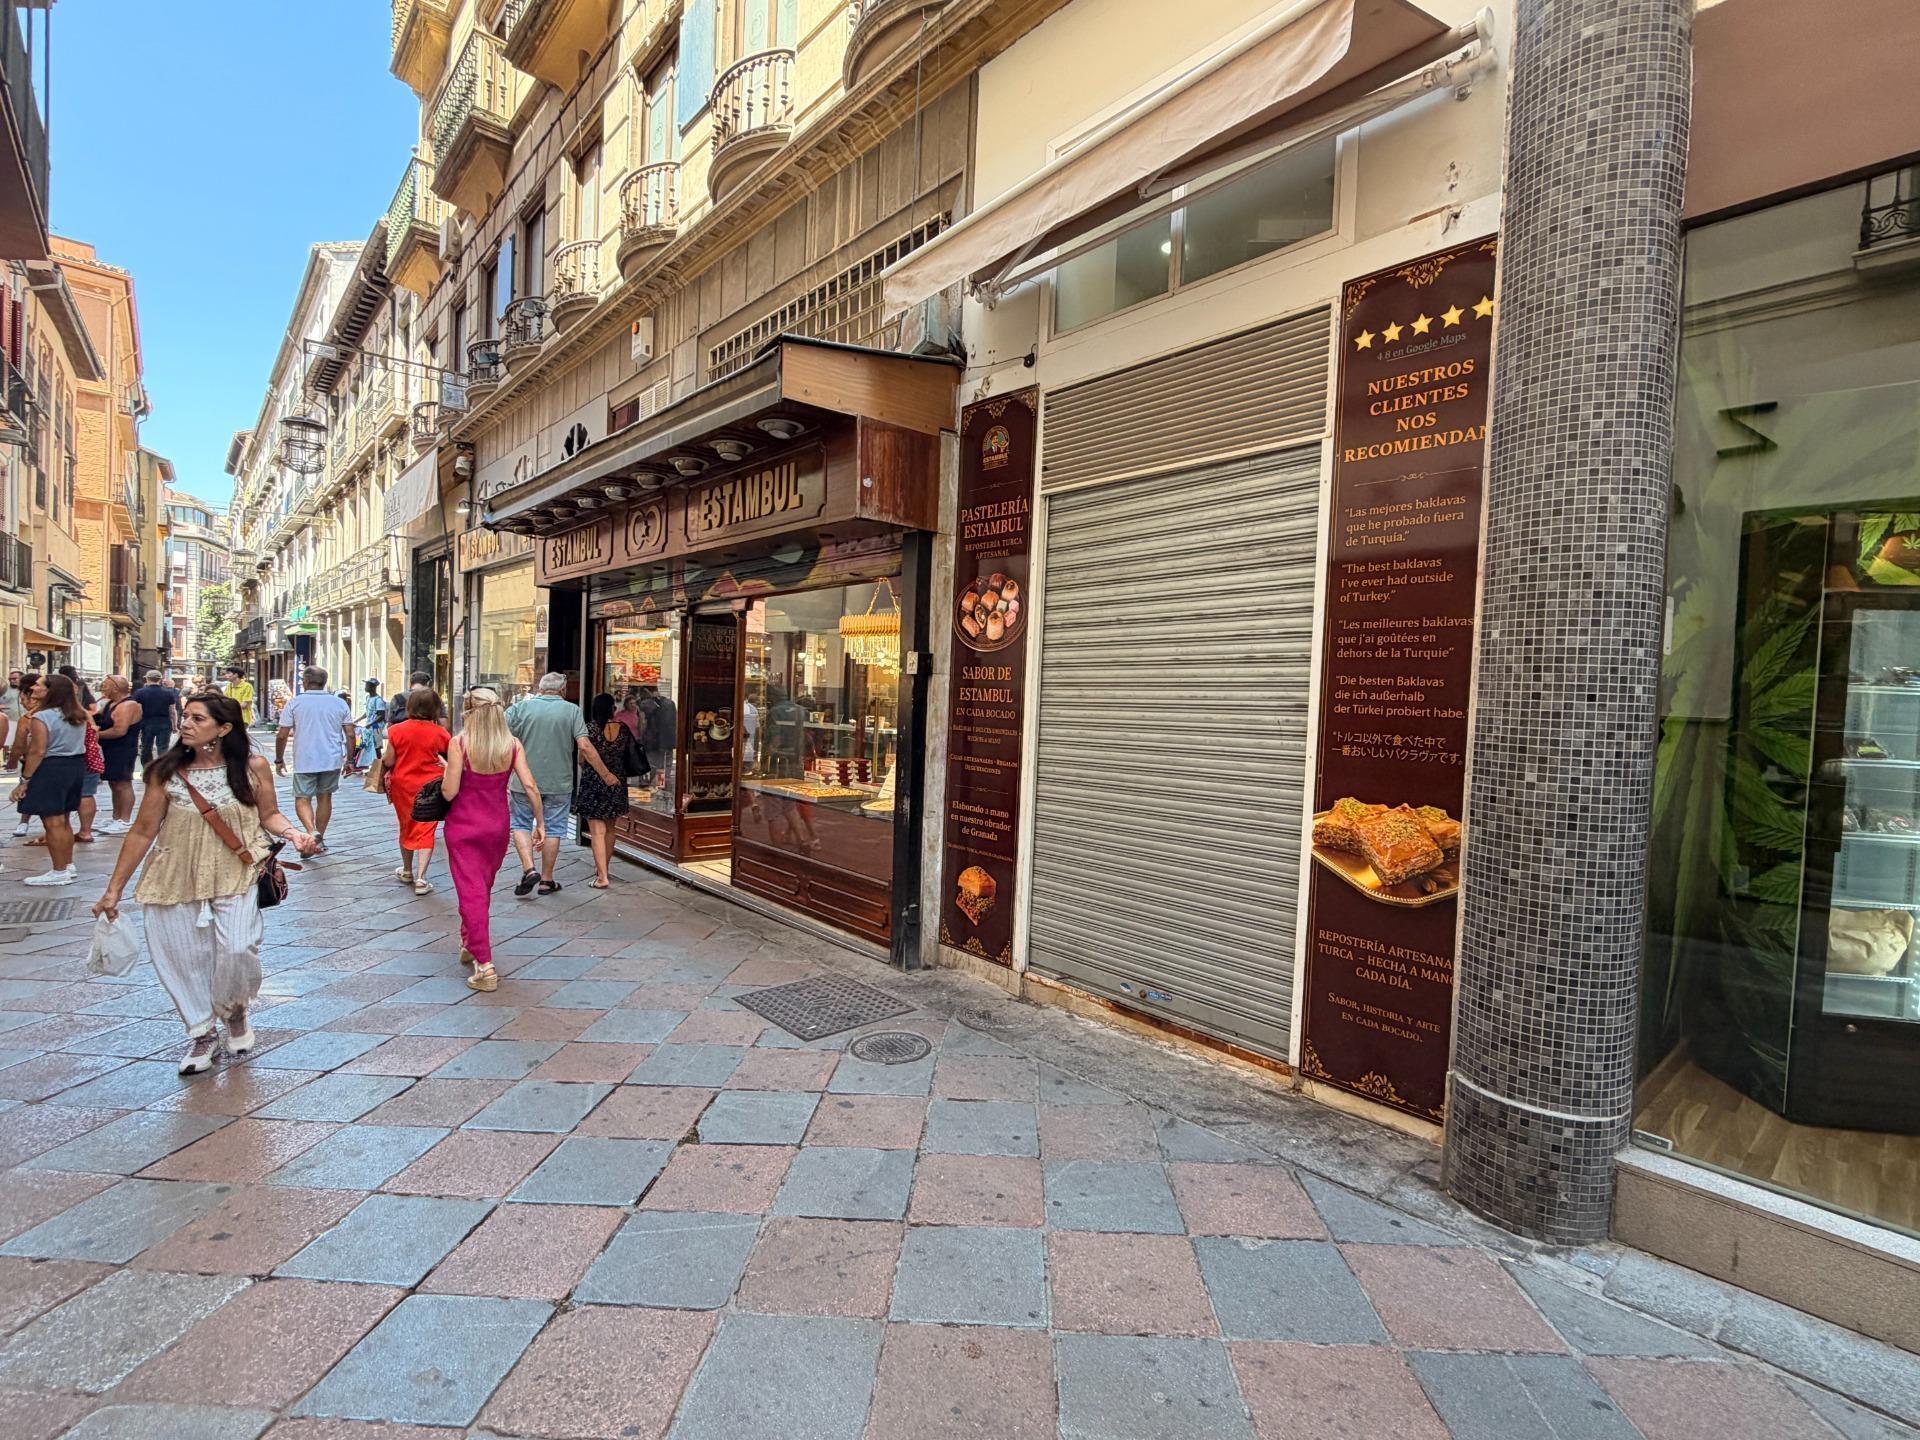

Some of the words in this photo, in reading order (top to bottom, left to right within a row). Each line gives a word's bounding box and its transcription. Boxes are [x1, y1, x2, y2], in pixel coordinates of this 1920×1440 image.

[1393, 348, 1404, 357] en
[1406, 339, 1439, 353] Google
[1440, 333, 1467, 345] Maps
[1366, 359, 1475, 396] NUESTROS
[1369, 383, 1470, 416] CLIENTES
[1395, 412, 1437, 433] NOS
[700, 462, 803, 531] ESTAMBUL
[961, 495, 1029, 523] PASTELERÍA
[1369, 501, 1412, 516] mejores
[1415, 496, 1466, 509] baklavas
[964, 517, 1024, 539] ESTAMBUL
[1346, 522, 1366, 534] que
[1368, 519, 1380, 531] he
[1383, 513, 1431, 531] probado
[1433, 511, 1464, 523] fuera
[550, 526, 602, 570] ESTAMBUL
[1002, 537, 1023, 547] TURCA
[1345, 536, 1359, 547] de
[975, 549, 1010, 560] ARTESANAL
[1368, 561, 1390, 572] best
[1393, 558, 1442, 570] baklavas
[1341, 577, 1359, 588] I've
[1361, 578, 1384, 587] ever
[1387, 574, 1408, 585] had
[1410, 571, 1454, 583] outside
[1340, 592, 1352, 603] of
[1362, 617, 1420, 629] meilleures
[1422, 616, 1474, 627] baklavas
[1338, 635, 1356, 647] que
[1358, 632, 1375, 646] j'ai
[1377, 632, 1420, 646] goûtées
[1422, 634, 1436, 643] en
[1336, 647, 1373, 658] dehors
[1375, 647, 1389, 658] de
[1391, 647, 1400, 658] la
[962, 665, 995, 680] SABOR
[997, 666, 1012, 681] DE
[1359, 675, 1394, 686] besten
[1397, 676, 1445, 687] Baklavas
[959, 687, 1013, 703] ESTAMBUL
[1334, 690, 1350, 700] die
[1352, 690, 1368, 700] ich
[1369, 690, 1425, 702] außerhalb
[956, 707, 965, 716] EN
[965, 707, 985, 718] CADA
[985, 708, 1016, 720] BOCADO
[1333, 704, 1352, 714] der
[1352, 704, 1383, 716] Türkei
[1386, 705, 1431, 719] probiert
[952, 800, 984, 813] Elaborado
[990, 809, 1009, 818] mano
[950, 813, 959, 821] en
[959, 815, 984, 826] nuestro
[984, 819, 1012, 832] obrador
[961, 826, 970, 835] de
[970, 827, 998, 841] Granada
[1318, 929, 1386, 954] REPOSTERÍA
[1388, 945, 1455, 970] ARTESANA
[1318, 943, 1354, 961] TURCA
[1367, 954, 1408, 974] HECHA
[1409, 965, 1418, 976] A
[1355, 967, 1387, 985] CADA
[1389, 973, 1413, 991] DÍA.
[1341, 1011, 1354, 1022] EN
[1355, 1015, 1380, 1030] CADA
[1381, 1023, 1424, 1043] BOCADO.
[1363, 1003, 1404, 1023] HISTORIA
[1406, 1016, 1414, 1025] Y
[1415, 1019, 1441, 1034] ARTE
